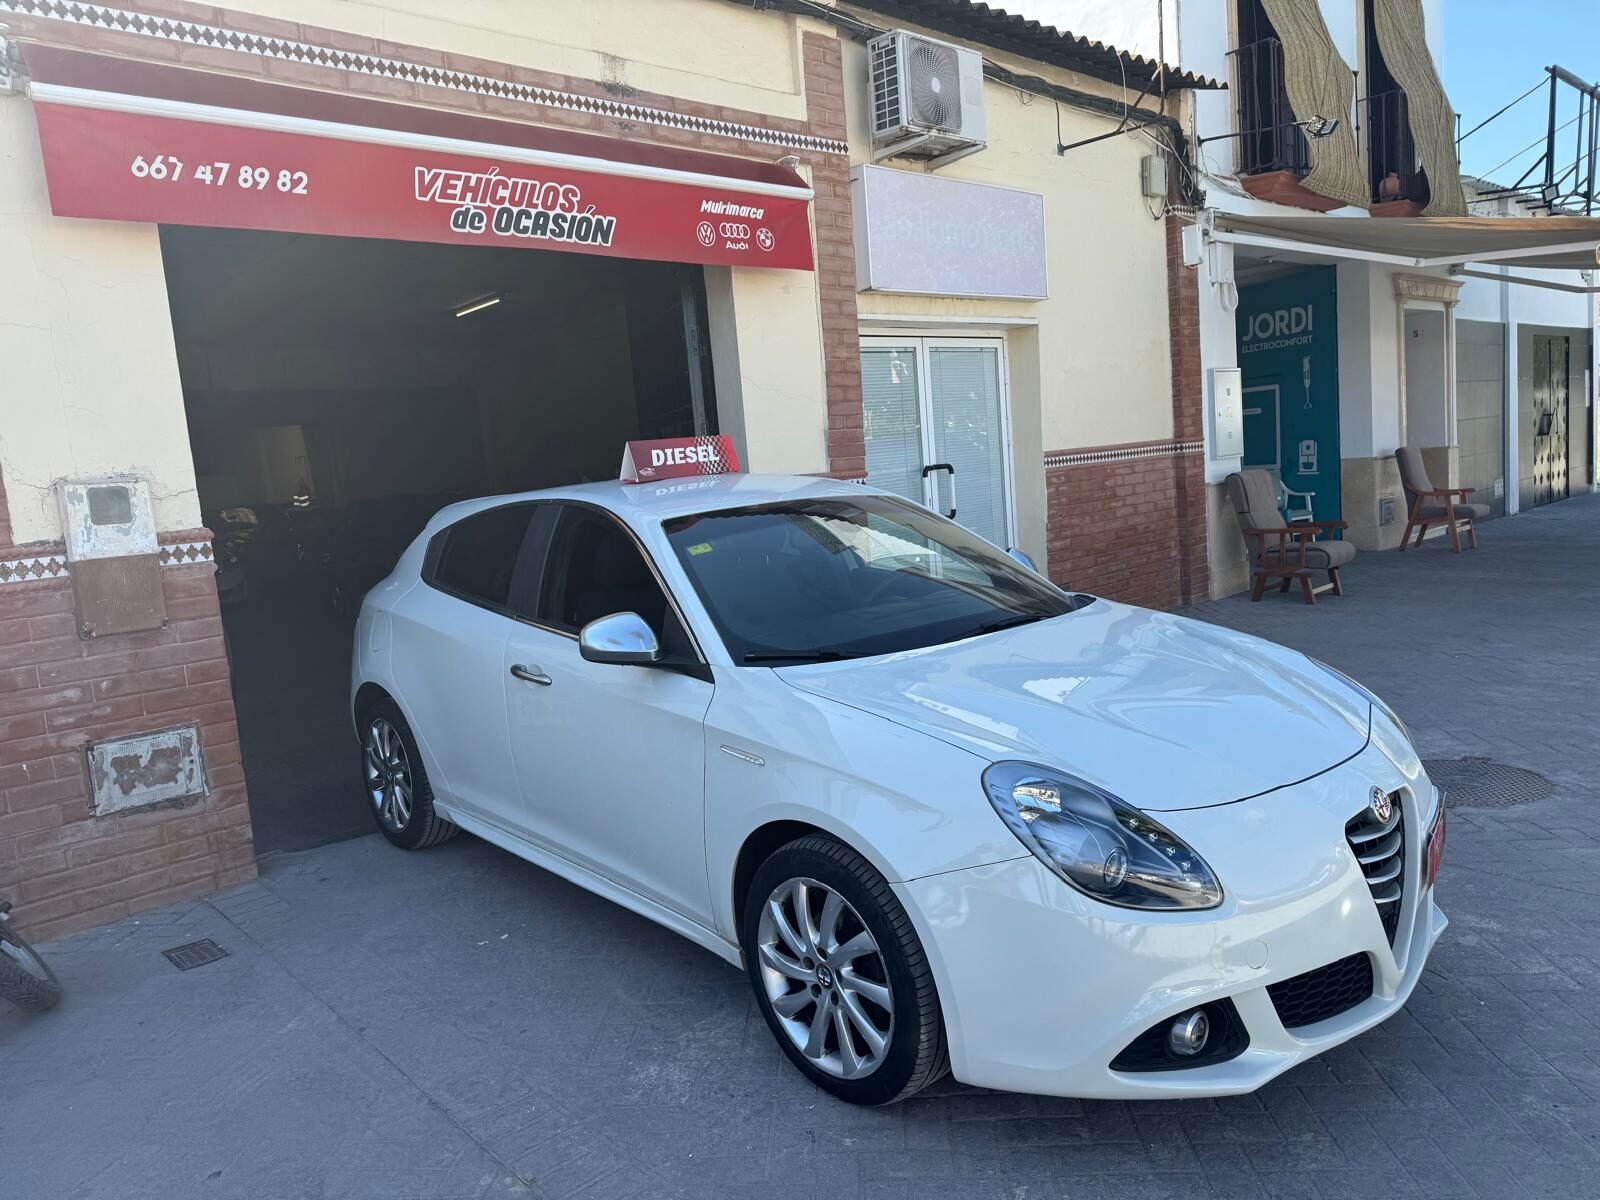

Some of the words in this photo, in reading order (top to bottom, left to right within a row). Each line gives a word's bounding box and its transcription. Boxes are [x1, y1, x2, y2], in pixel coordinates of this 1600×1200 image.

[131, 155, 184, 181] 667
[193, 161, 231, 186] 47
[237, 165, 270, 190] 89
[276, 169, 308, 195] 82
[414, 166, 581, 214] VEHÍCULOS
[449, 205, 488, 234] de
[491, 204, 617, 247] OCASIÓN
[725, 240, 750, 250] Audi
[1242, 304, 1313, 342] JORDI
[1241, 335, 1313, 354] ELECTROCONFORT
[651, 445, 720, 466] DIESEL
